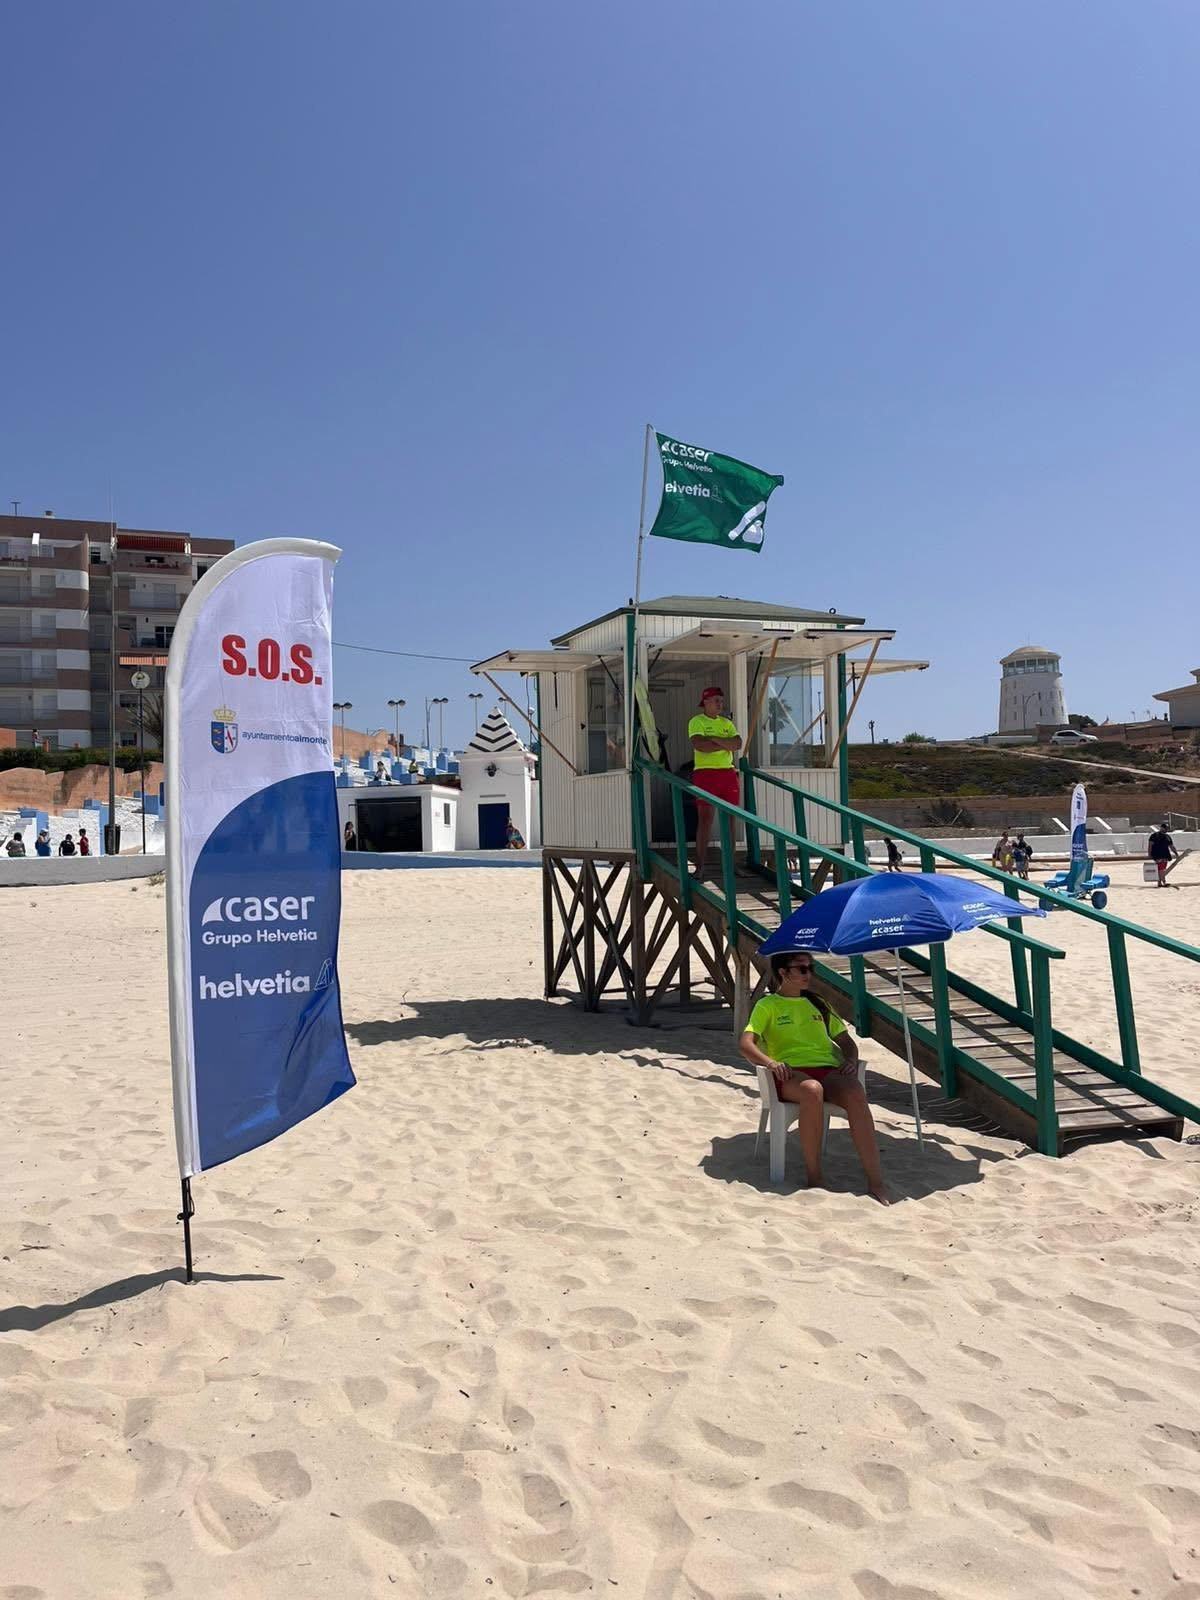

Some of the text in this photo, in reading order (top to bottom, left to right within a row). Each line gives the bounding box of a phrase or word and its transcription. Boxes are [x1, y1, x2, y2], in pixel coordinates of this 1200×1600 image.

[670, 443, 714, 462] caser
[665, 481, 710, 497] elvetia
[222, 634, 322, 685] S.O.S.
[225, 896, 315, 922] caser
[202, 928, 317, 947] Grupo Helvetia
[878, 925, 904, 933] caser
[200, 970, 310, 999] helvetia
